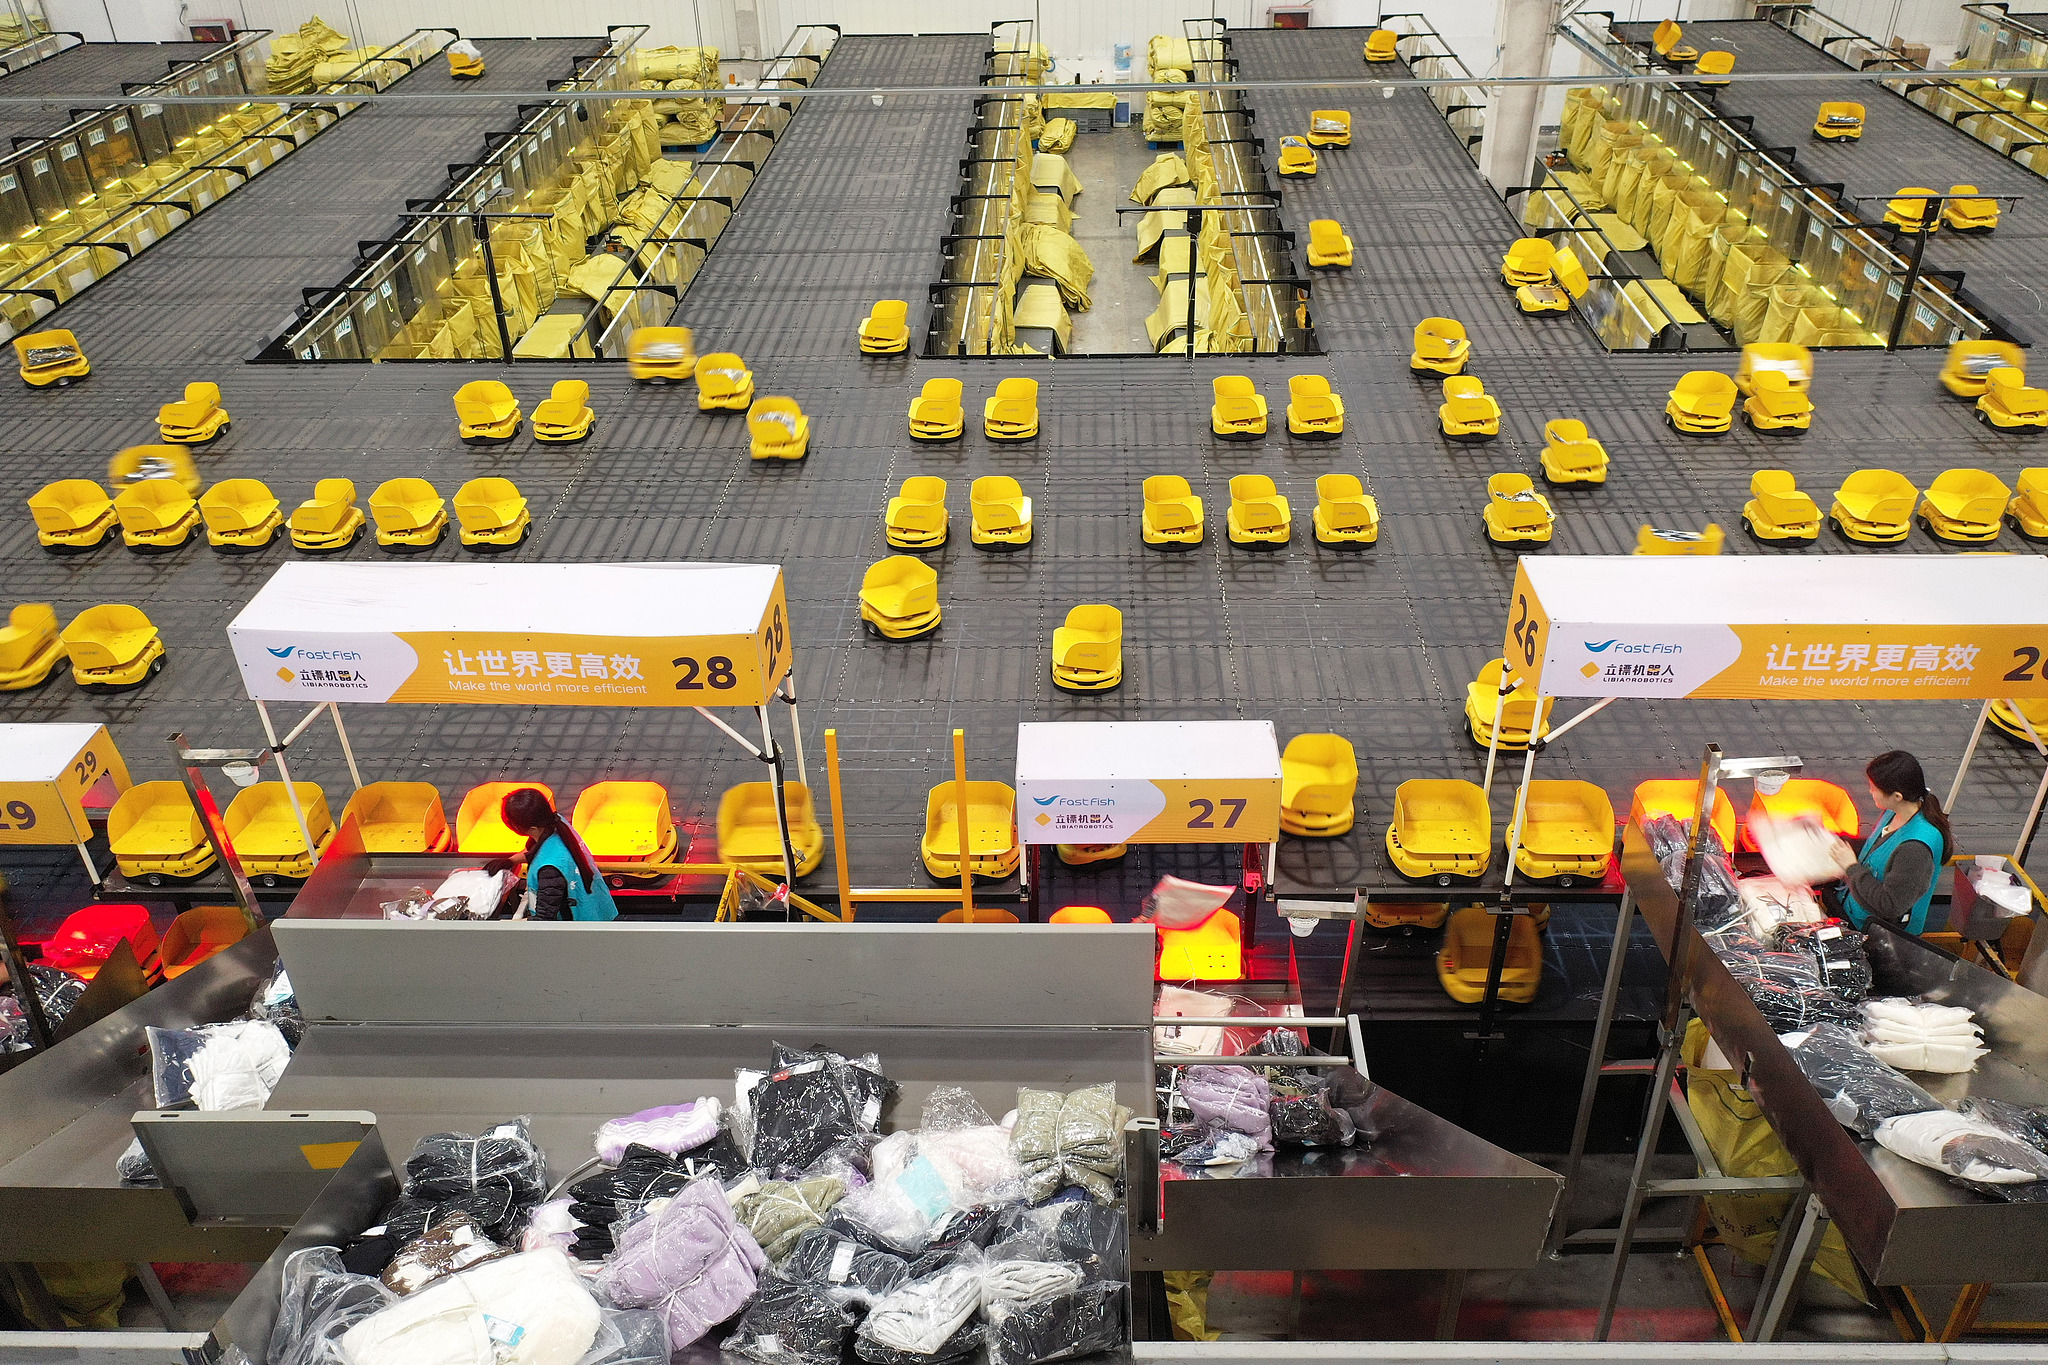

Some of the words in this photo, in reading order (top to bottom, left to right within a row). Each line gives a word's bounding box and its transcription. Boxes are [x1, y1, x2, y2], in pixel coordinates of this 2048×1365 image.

[765, 603, 784, 682] 28
[1513, 593, 1539, 668] 26
[443, 649, 645, 681] 让世界更高效
[671, 655, 737, 690] 28
[1765, 643, 1981, 672] 让世界更高效
[2002, 646, 2048, 682] 2
[448, 680, 486, 692] Make
[490, 681, 511, 692] the
[514, 682, 551, 693] world
[555, 683, 590, 694] more
[593, 682, 648, 695] efficient
[1759, 675, 1799, 687] Make
[1803, 675, 1825, 687] the
[1830, 675, 1868, 687] world
[1872, 677, 1910, 687] more
[1914, 675, 1972, 687] efficient
[75, 750, 97, 786] 29
[1187, 798, 1248, 829] 27
